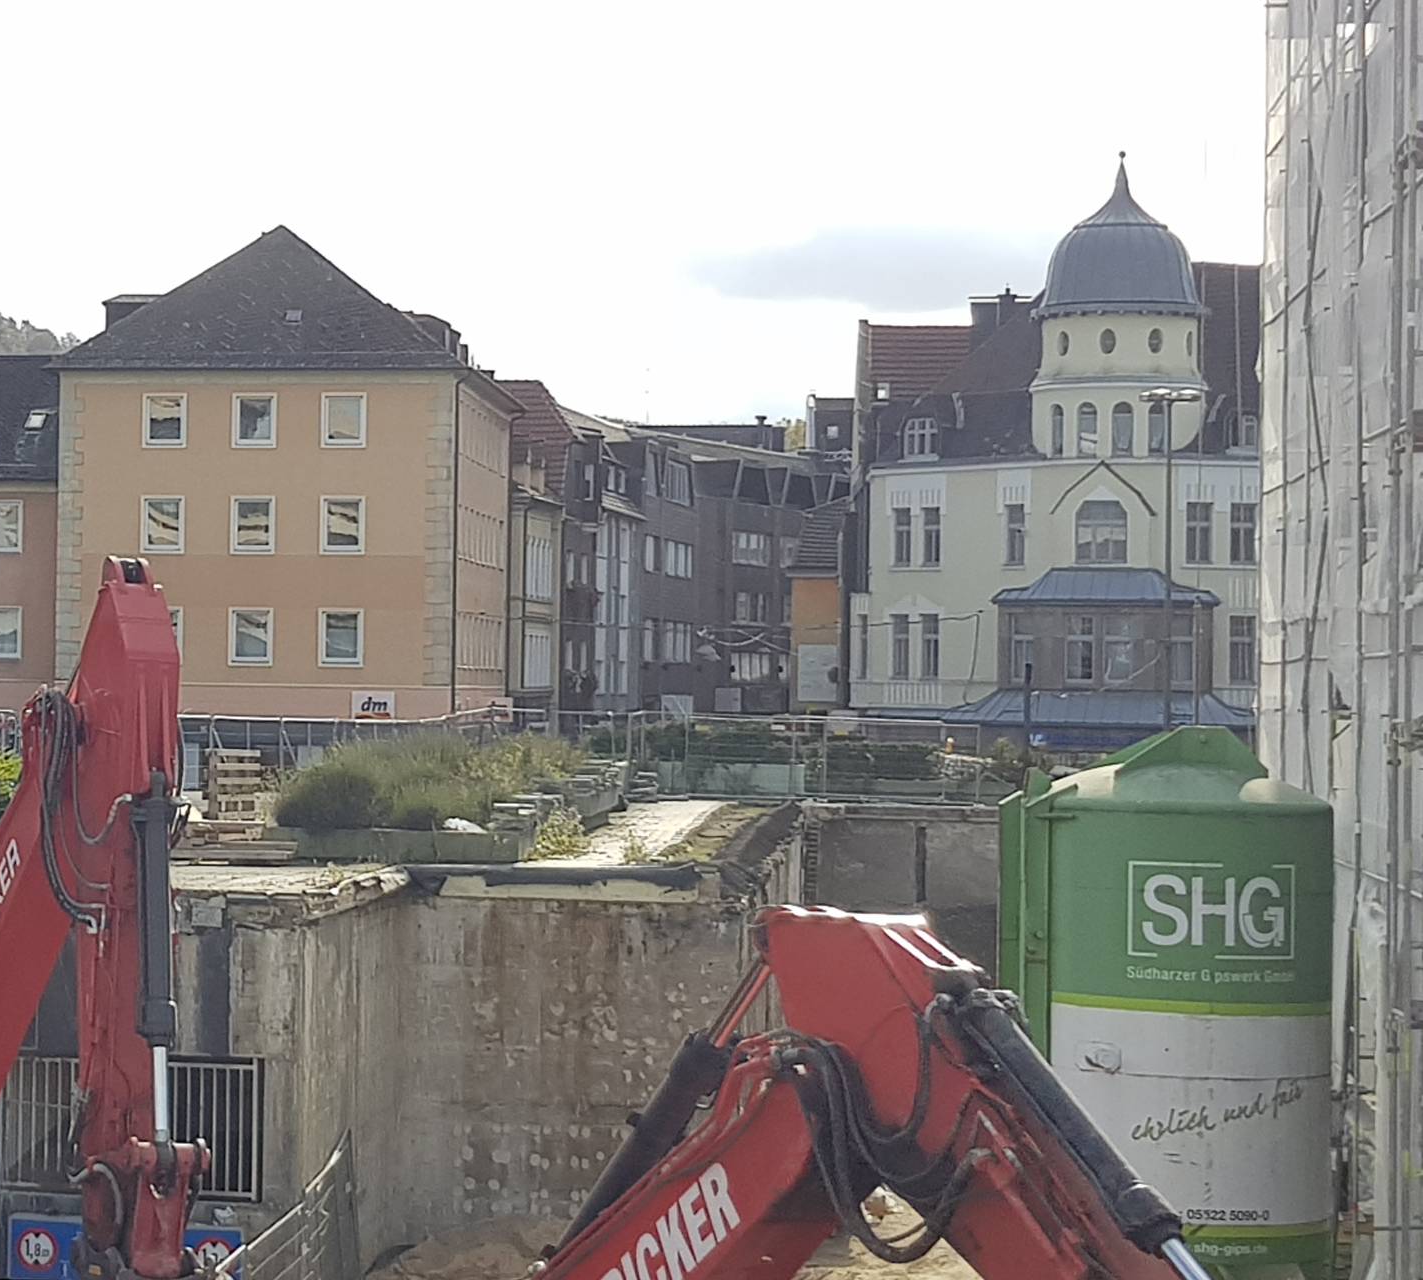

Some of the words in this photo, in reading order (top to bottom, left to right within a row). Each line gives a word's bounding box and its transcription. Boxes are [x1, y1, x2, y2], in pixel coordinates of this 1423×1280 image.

[361, 697, 388, 712] dm
[1142, 874, 1285, 948] SHG
[1127, 966, 1196, 981] Südharzer
[1201, 970, 1261, 984] Gpswerk
[1224, 1092, 1267, 1122] und
[600, 1162, 741, 1280] CKER
